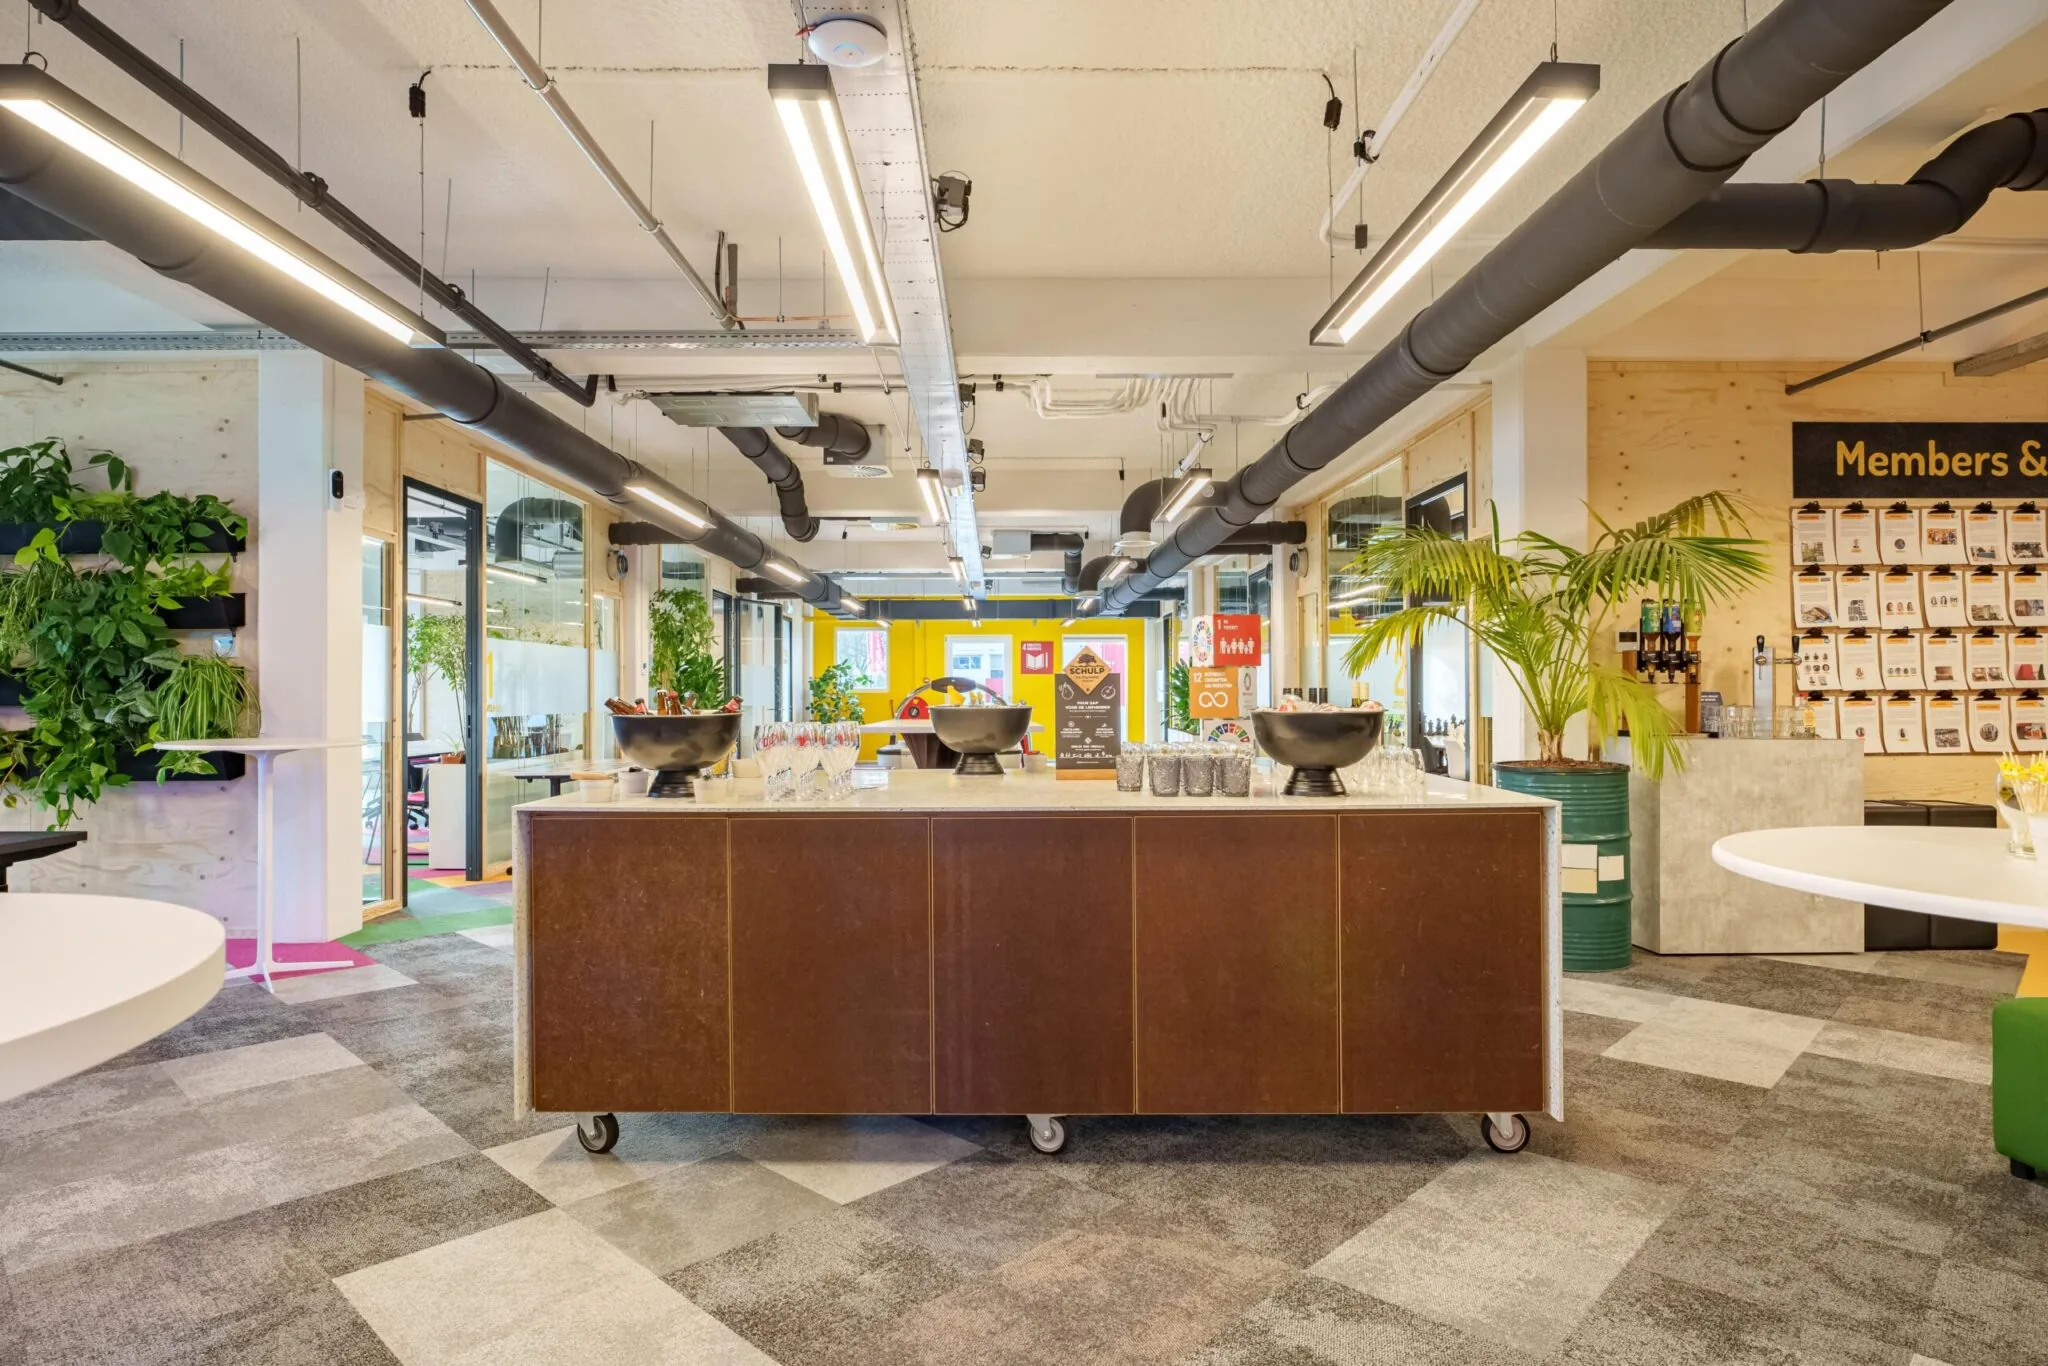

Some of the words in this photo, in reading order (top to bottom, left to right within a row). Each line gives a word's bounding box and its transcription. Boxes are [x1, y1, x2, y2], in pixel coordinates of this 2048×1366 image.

[1836, 440, 2009, 477] Members
[2019, 440, 2048, 477] &
[1217, 619, 1221, 630] 1
[1069, 667, 1105, 675] SCHULP
[1193, 672, 1202, 683] 12
